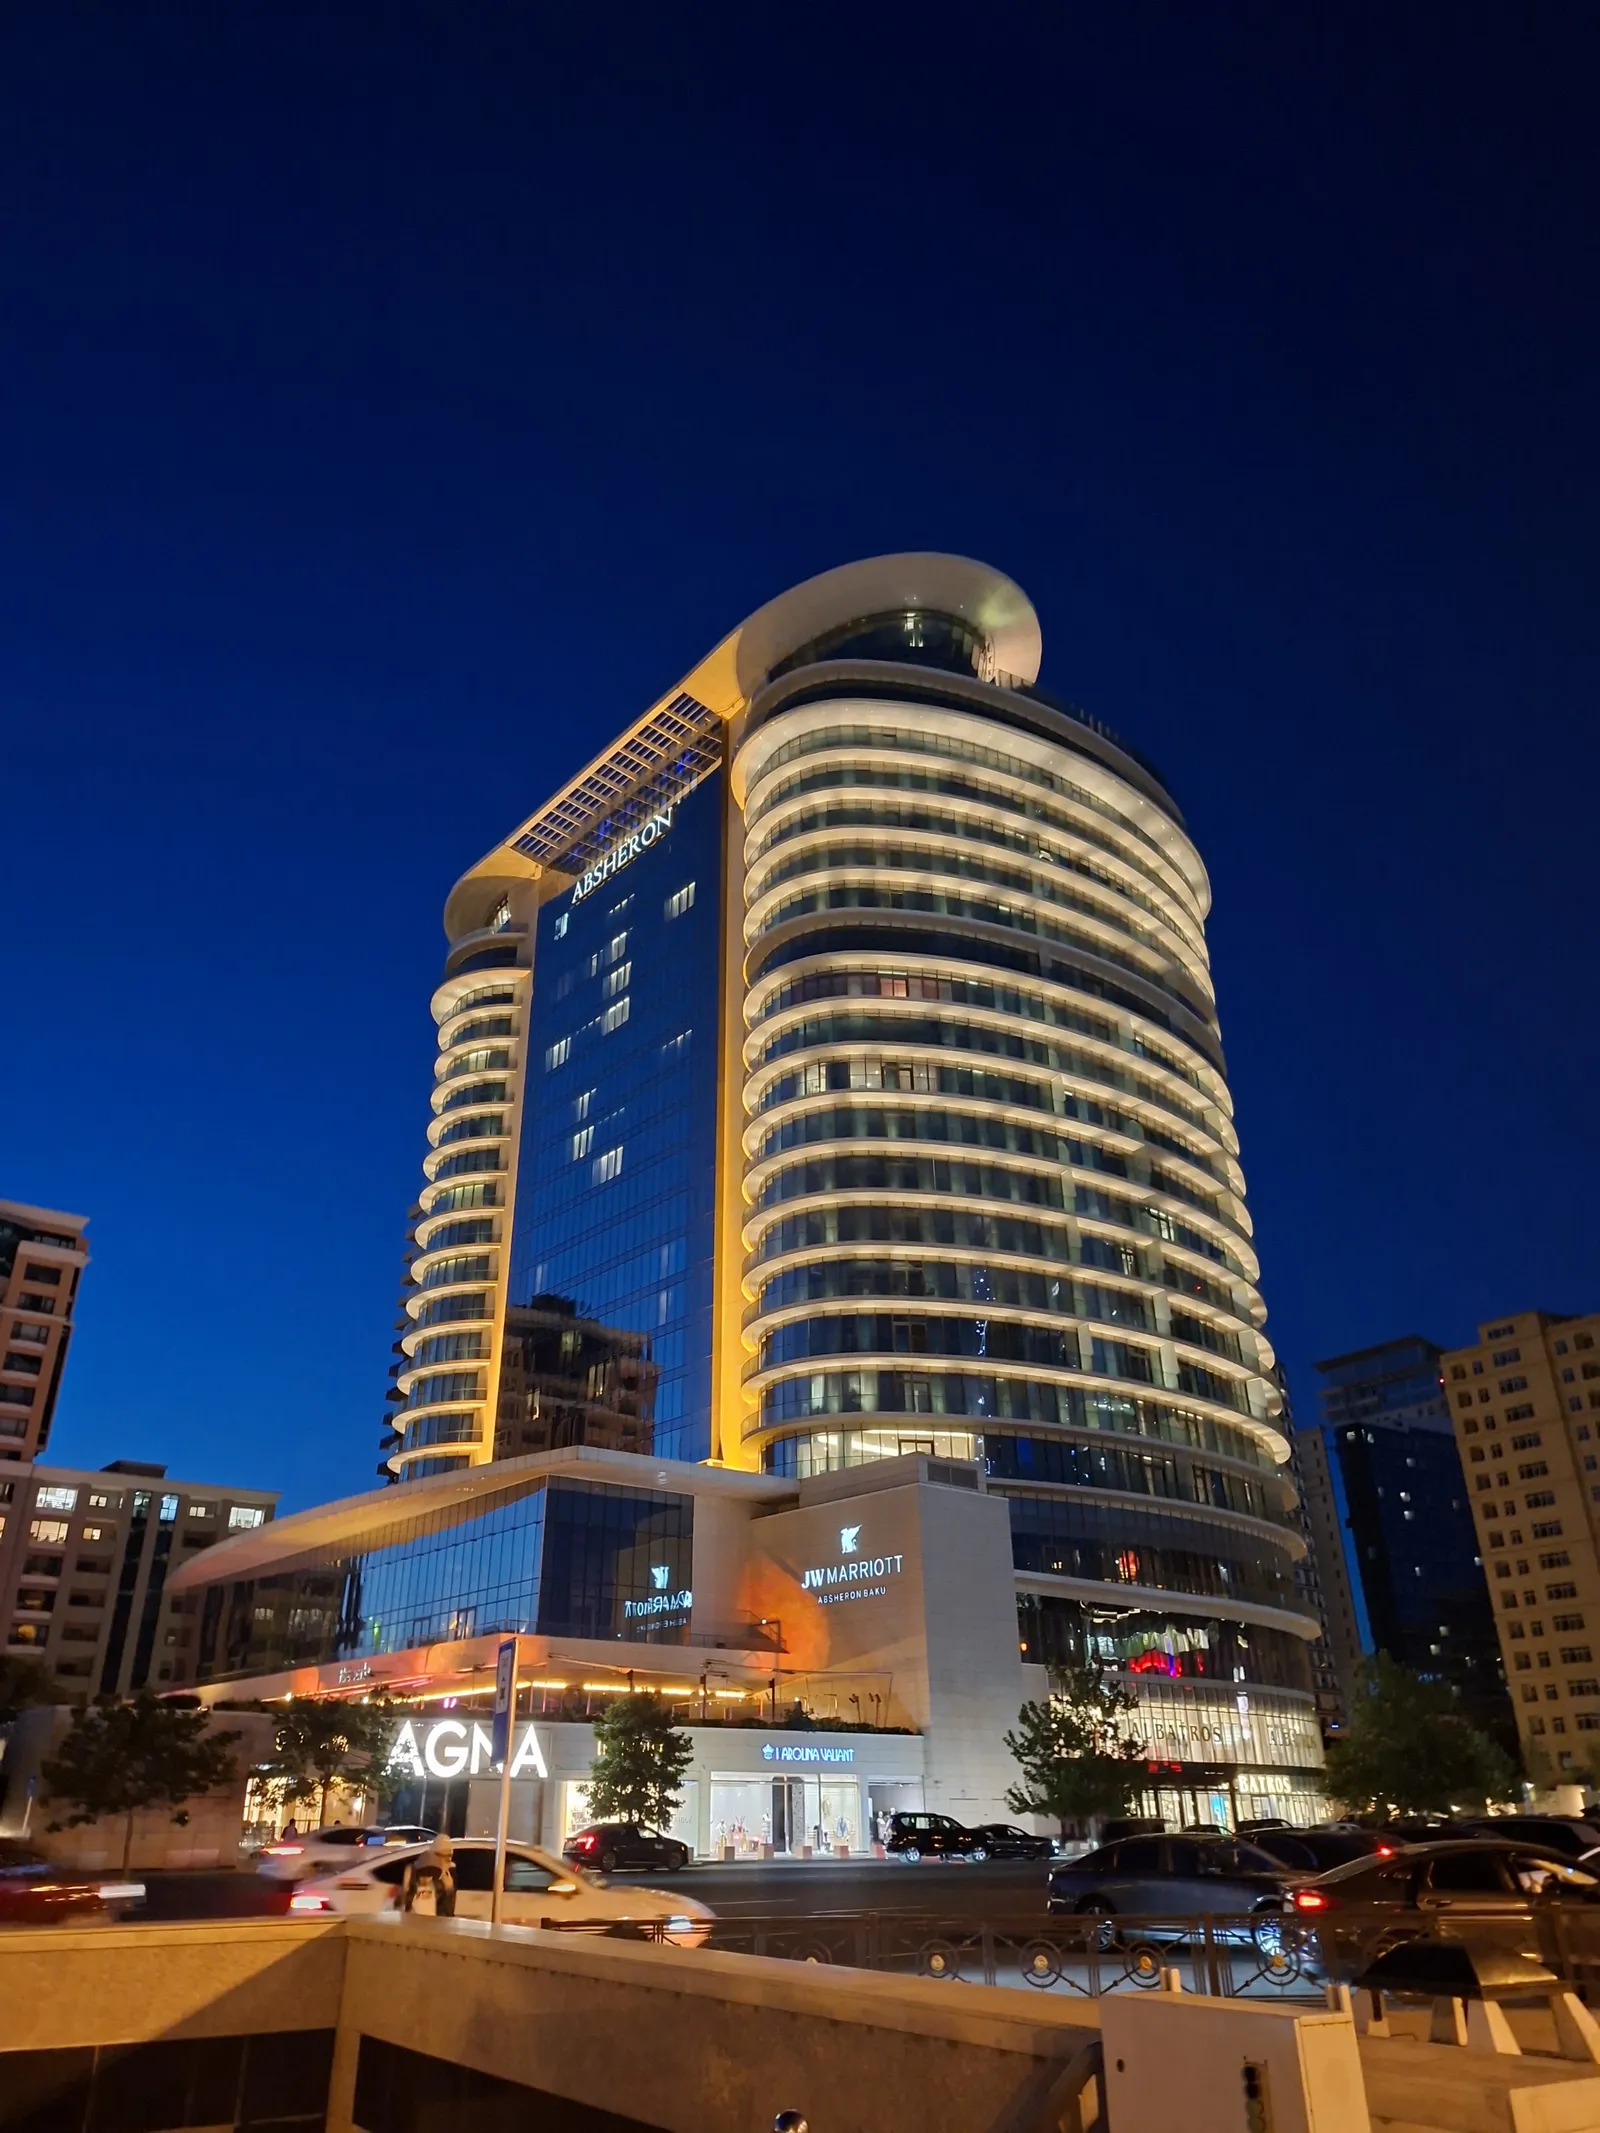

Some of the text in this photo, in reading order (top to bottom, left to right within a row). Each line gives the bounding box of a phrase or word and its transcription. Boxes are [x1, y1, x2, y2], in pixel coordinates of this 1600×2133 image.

[571, 806, 674, 905] ABSHERON
[801, 1554, 903, 1589] JW MARRIOTT
[817, 1585, 887, 1605] ABSHERON BAKU
[1132, 1722, 1223, 1743] ALBATROS
